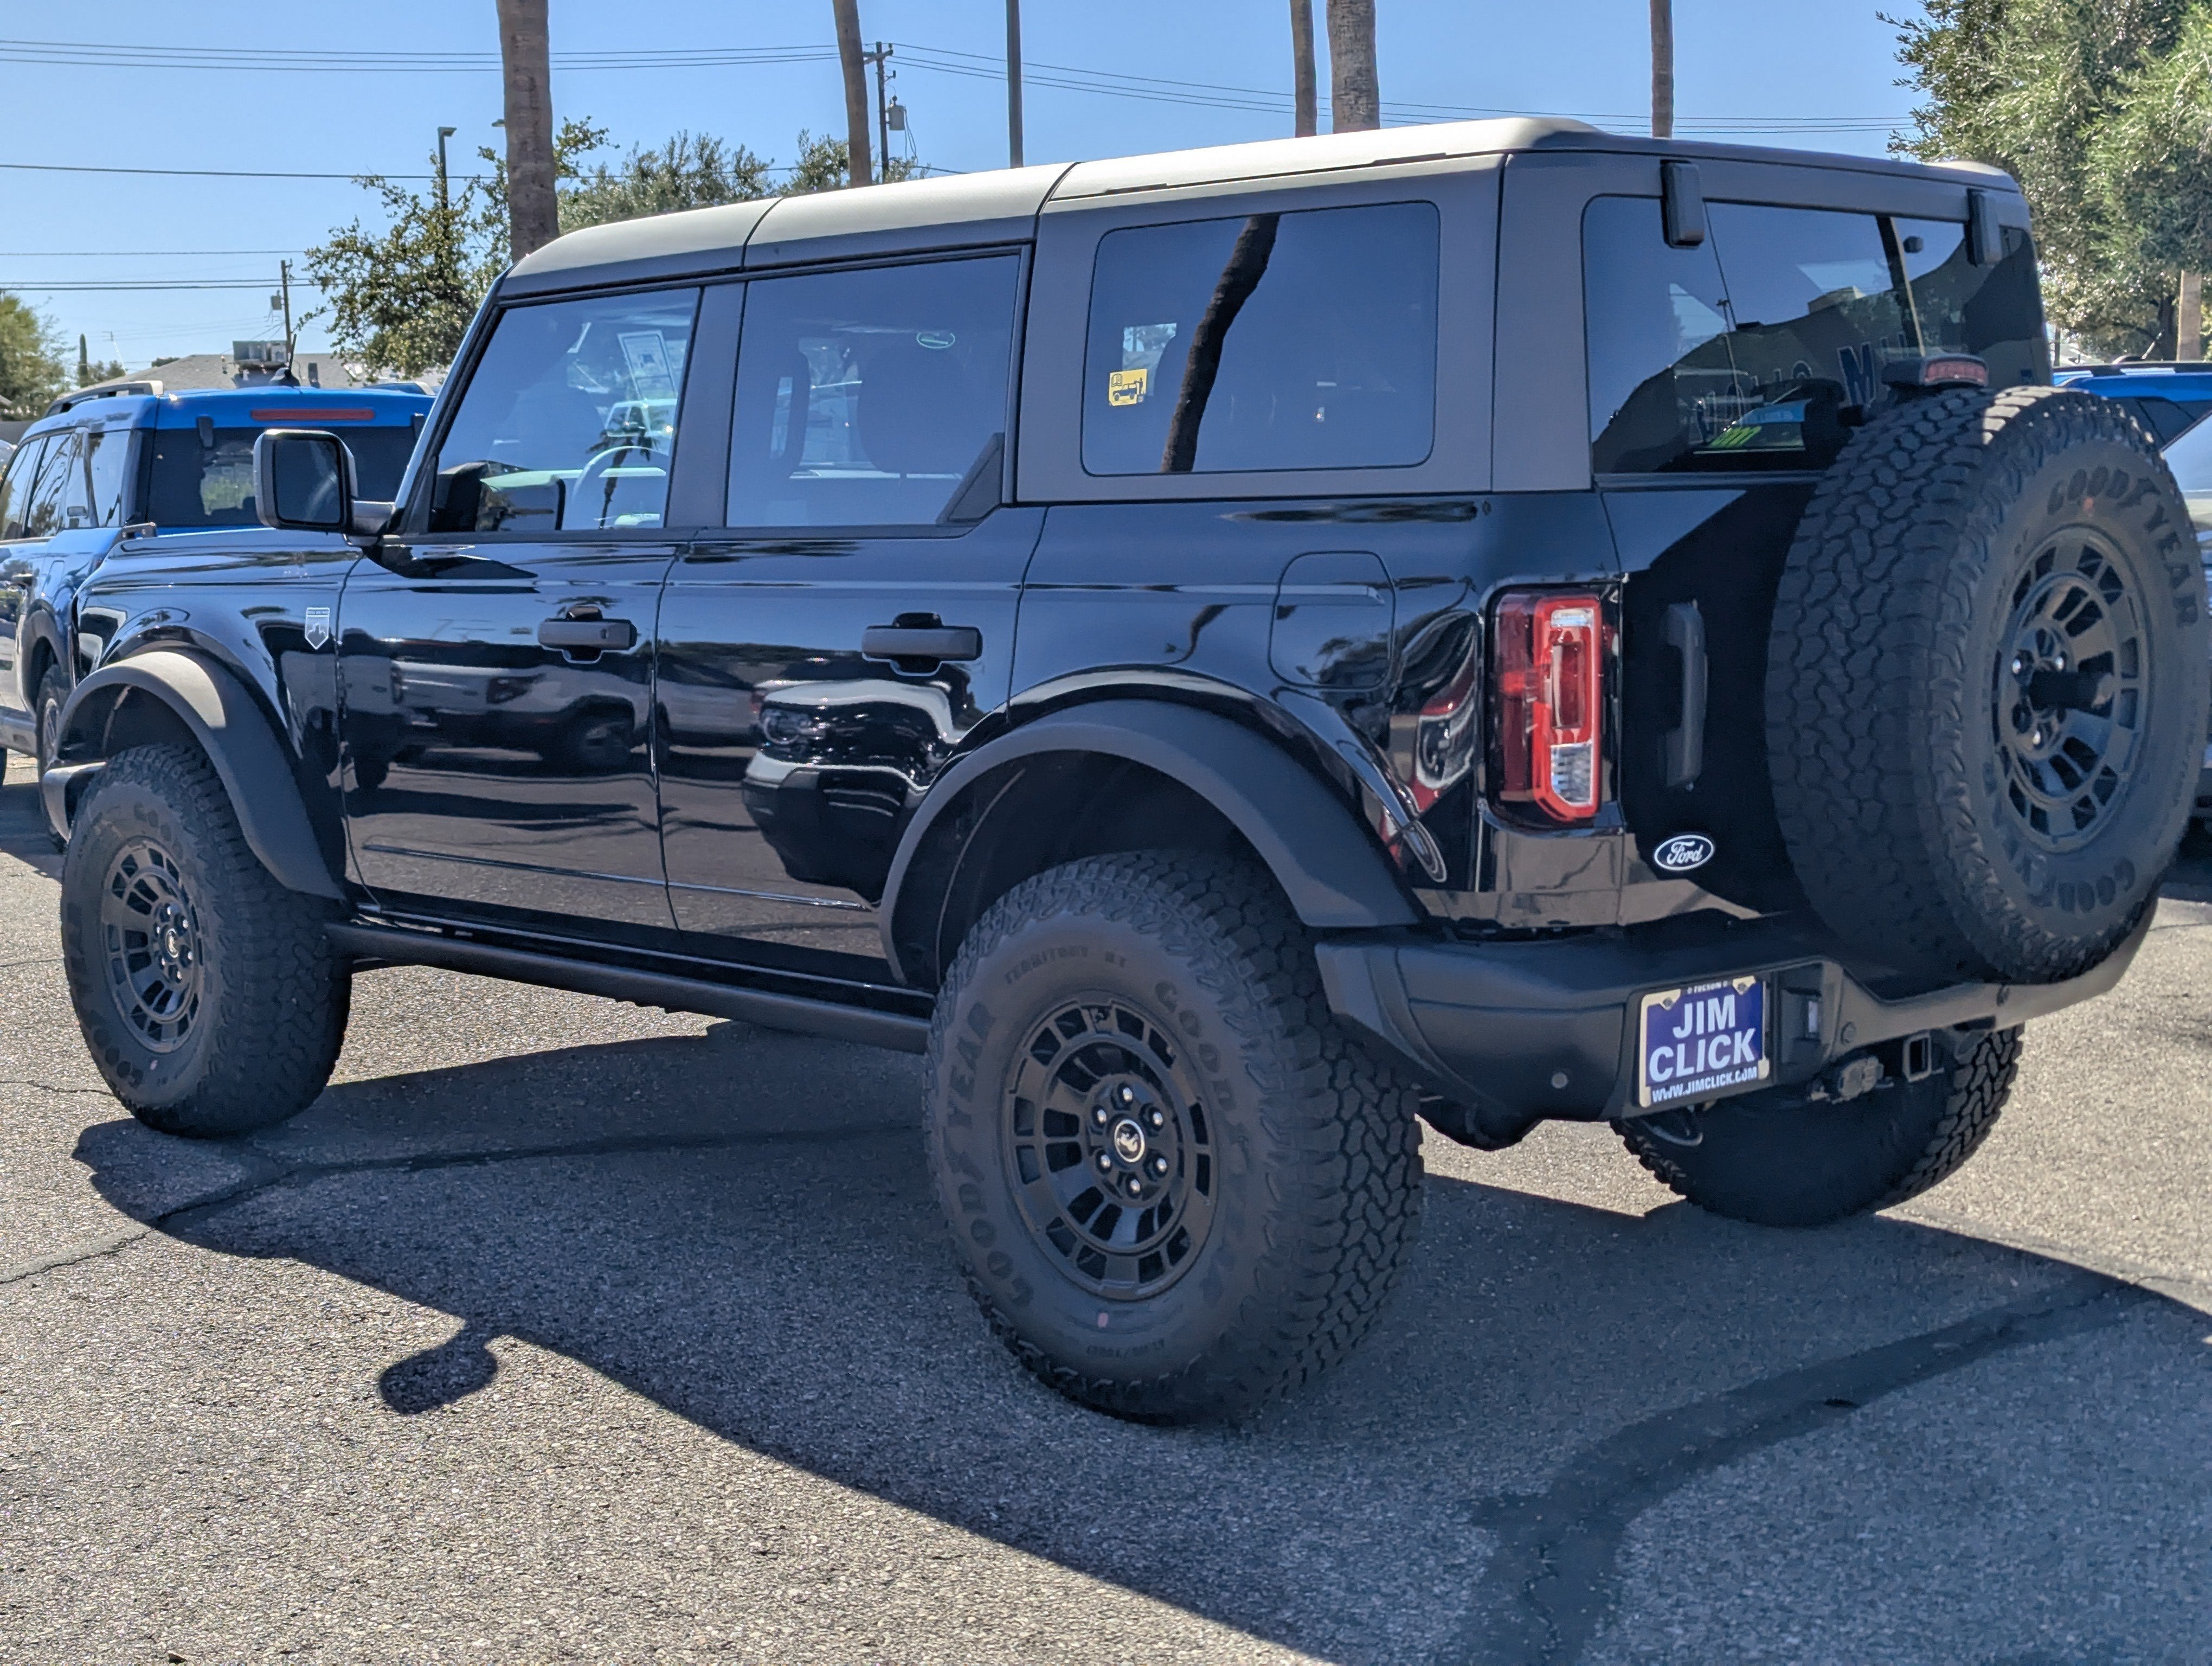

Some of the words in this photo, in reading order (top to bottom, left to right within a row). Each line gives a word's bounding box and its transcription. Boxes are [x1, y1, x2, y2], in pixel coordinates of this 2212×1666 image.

[2047, 465, 2199, 629] GOODYEAR
[1666, 841, 1704, 865] Ford
[1673, 994, 1735, 1039] JIM
[1649, 1028, 1756, 1082] CLICK
[1652, 1066, 1757, 1103] WWW.JIMCLICK.COM
